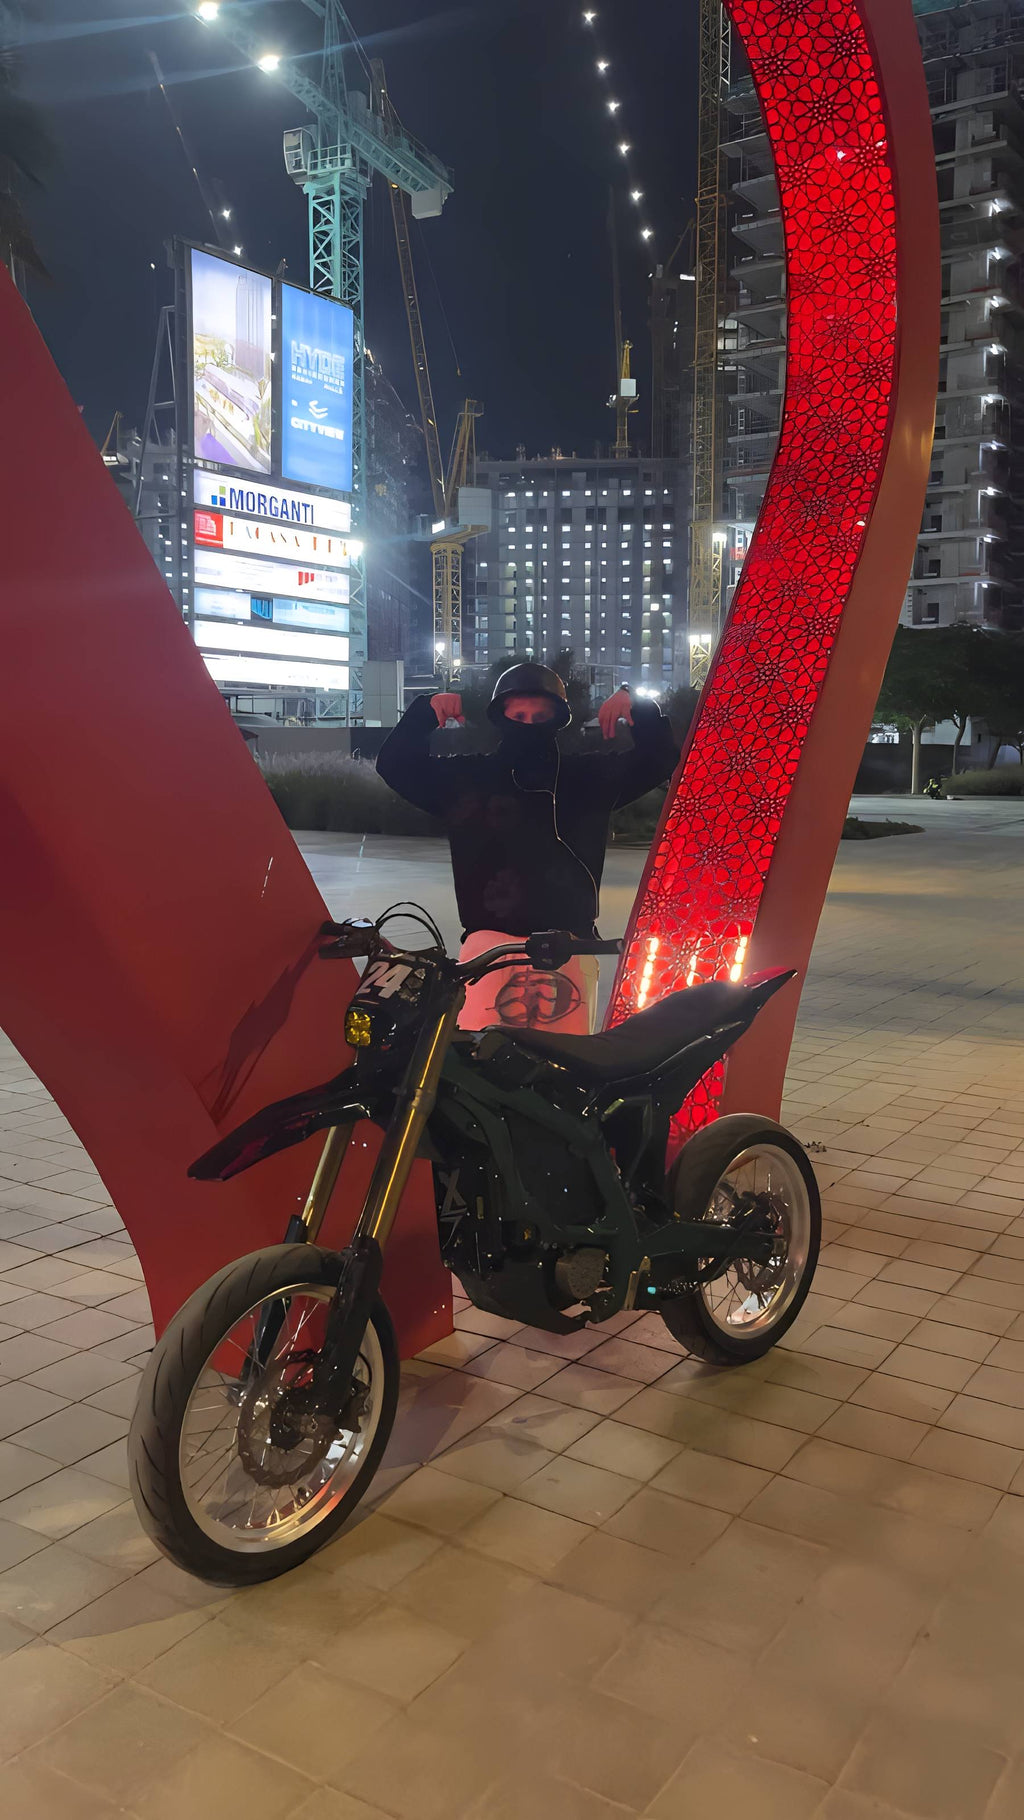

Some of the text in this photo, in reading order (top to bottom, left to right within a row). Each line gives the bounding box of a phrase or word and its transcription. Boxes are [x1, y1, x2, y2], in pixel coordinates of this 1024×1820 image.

[291, 340, 345, 380] HYDE
[229, 487, 314, 525] MORGANTI
[355, 961, 413, 999] 24
